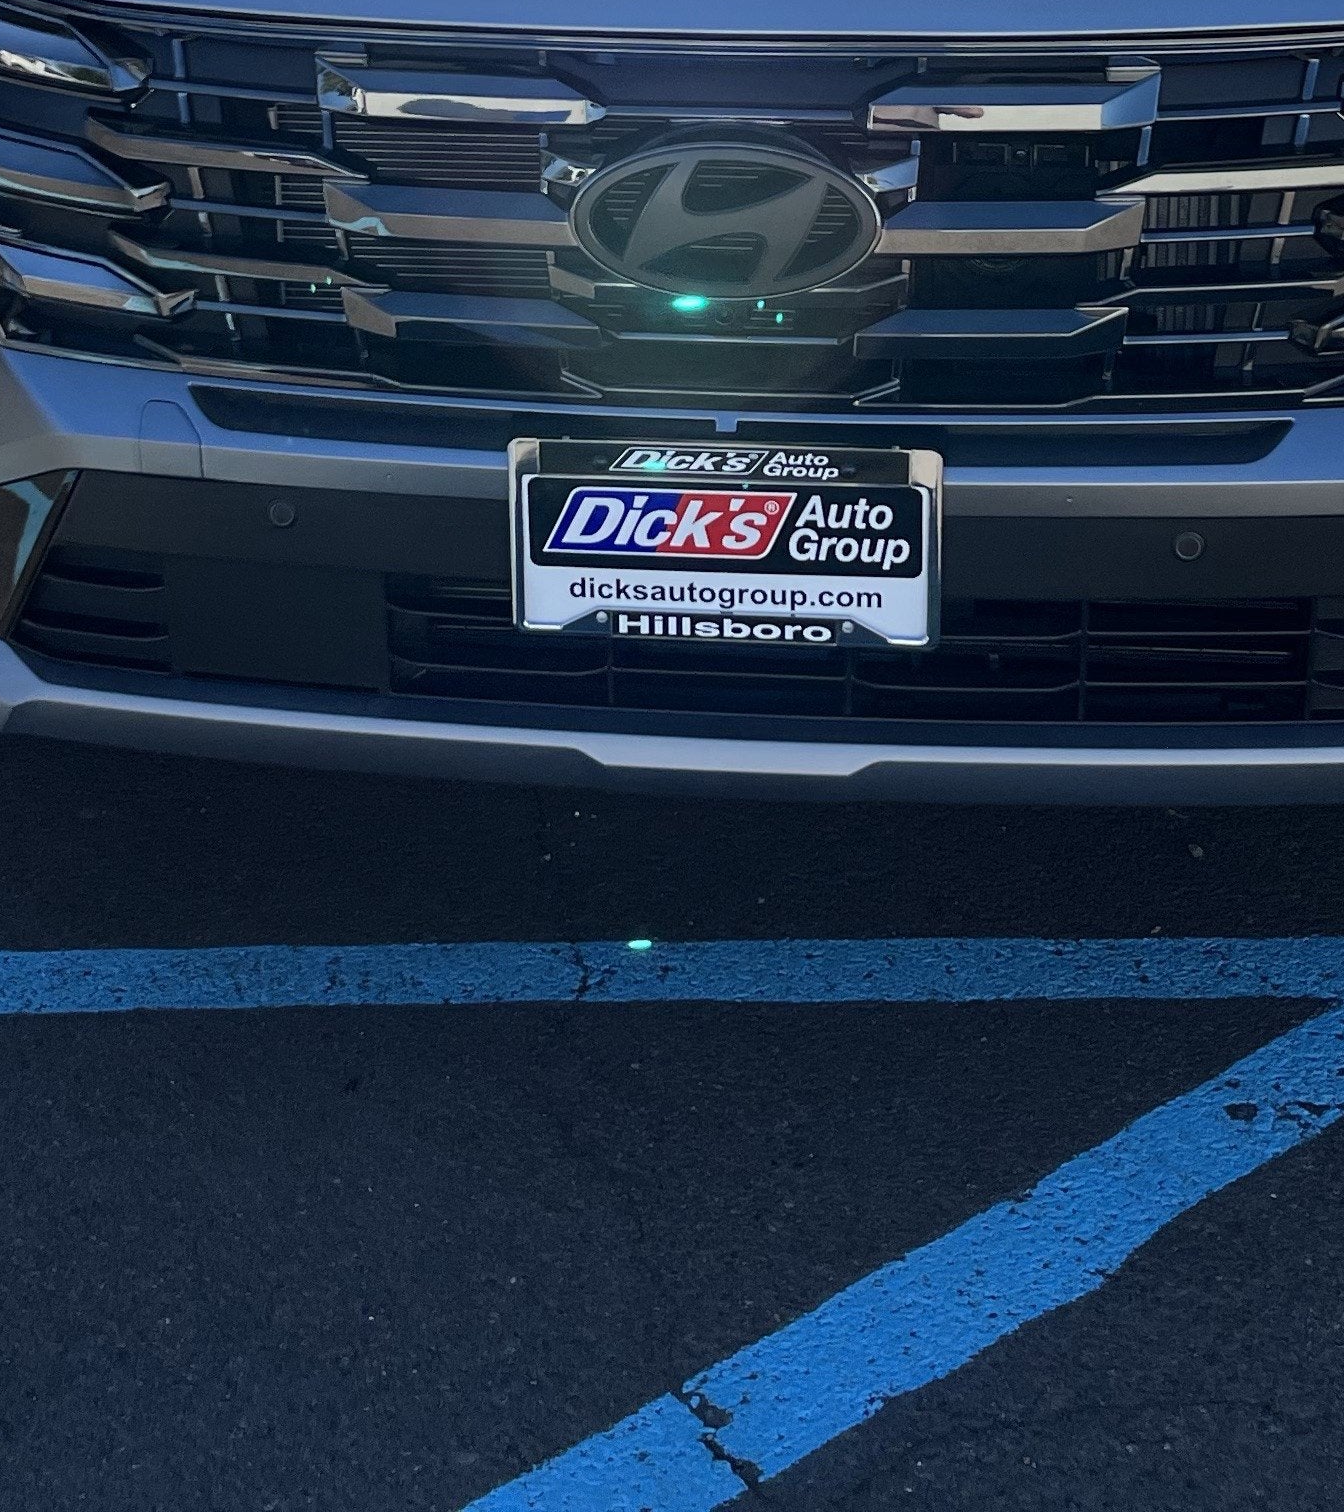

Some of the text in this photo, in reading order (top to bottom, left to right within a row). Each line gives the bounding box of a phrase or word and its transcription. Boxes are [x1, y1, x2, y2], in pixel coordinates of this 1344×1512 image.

[623, 449, 752, 474] Dick's
[762, 464, 839, 481] Group
[767, 451, 829, 466] Auto
[561, 494, 767, 550] Dick's
[795, 494, 894, 530] Auto
[788, 527, 911, 571] Group
[568, 576, 883, 609] dicksautogroup.com
[618, 613, 833, 642] Hillsboro
